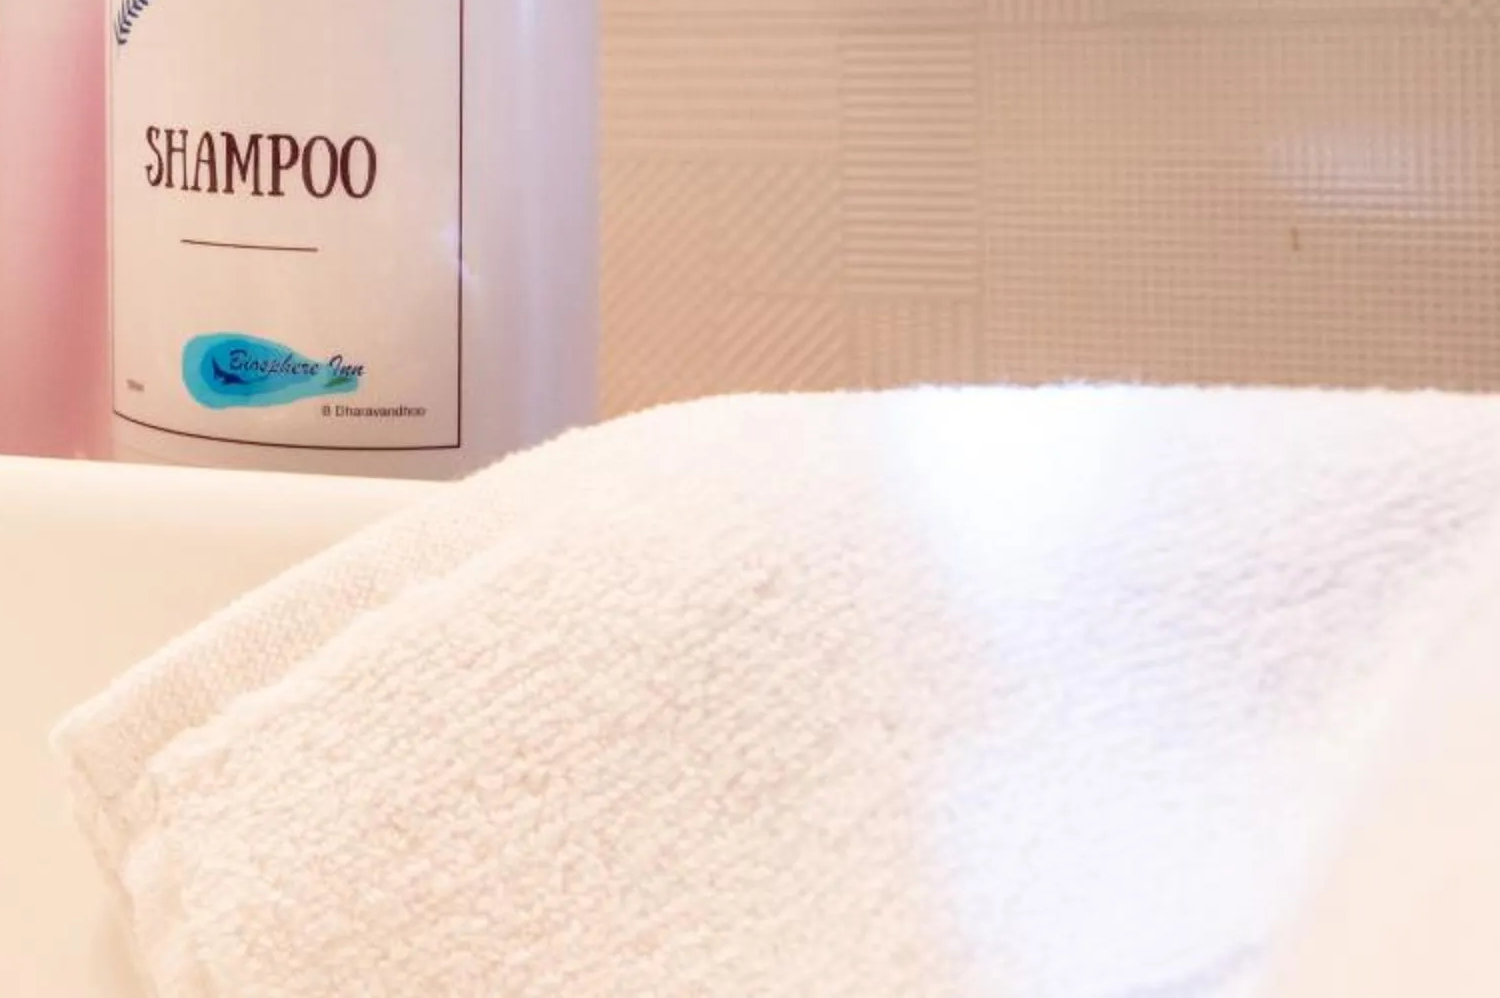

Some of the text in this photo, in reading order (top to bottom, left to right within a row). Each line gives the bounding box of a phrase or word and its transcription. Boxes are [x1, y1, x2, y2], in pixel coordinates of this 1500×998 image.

[144, 125, 377, 199] SHAMPOO
[229, 348, 366, 378] Biosphere Inn
